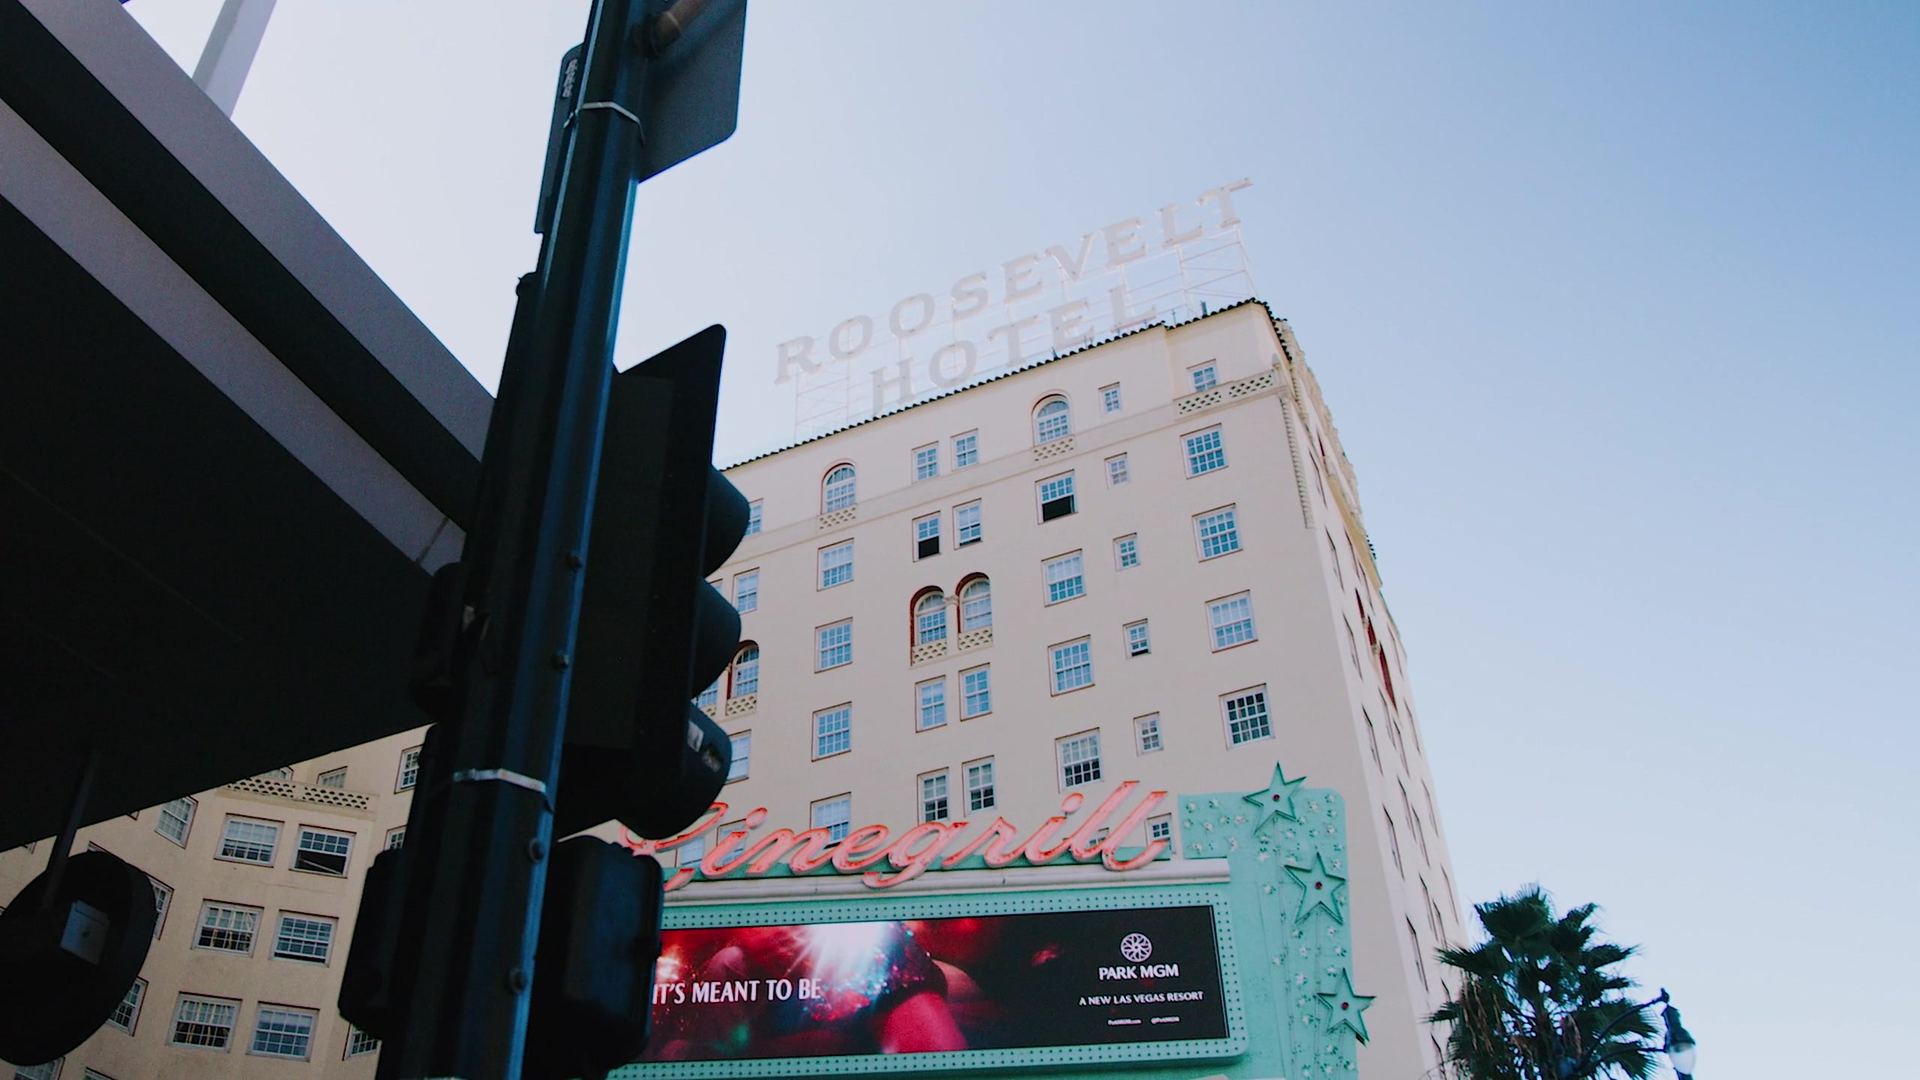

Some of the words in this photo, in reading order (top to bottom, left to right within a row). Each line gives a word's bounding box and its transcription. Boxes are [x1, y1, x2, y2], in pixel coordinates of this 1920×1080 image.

[774, 177, 1254, 385] ROOSEVELT
[871, 283, 1156, 417] HOTEL
[1099, 967, 1138, 980] PARK
[1140, 964, 1179, 978] MGM
[653, 983, 686, 1004] IT'S
[692, 980, 760, 1003] MEANT
[766, 978, 793, 1001] TO
[798, 977, 822, 999] BE
[1079, 997, 1087, 1006] A
[1088, 996, 1112, 1005] NEW
[1113, 994, 1132, 1004] LAS
[1133, 992, 1166, 1003] VEGAS
[1167, 991, 1204, 1002] RESORT
